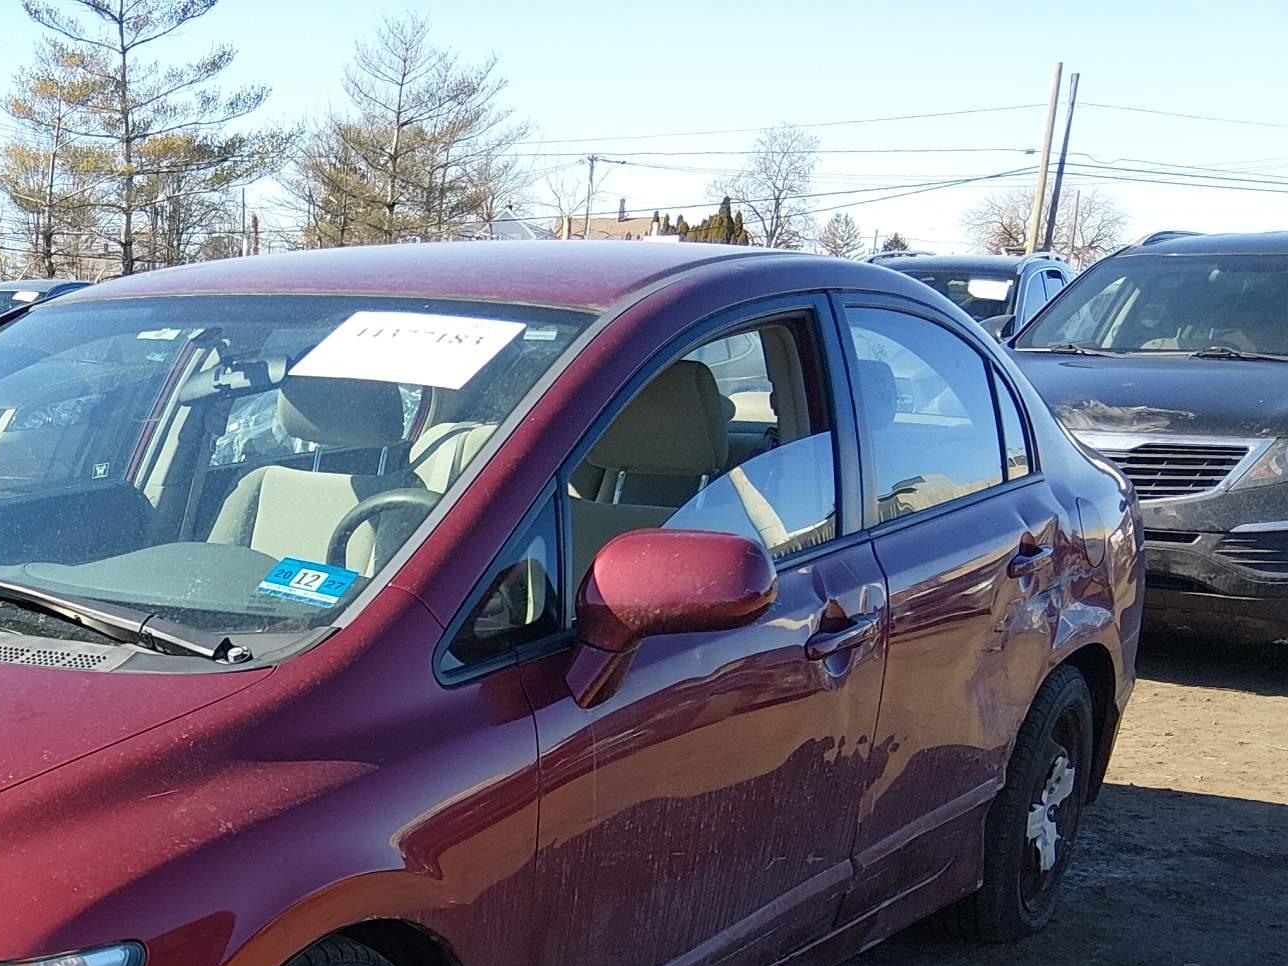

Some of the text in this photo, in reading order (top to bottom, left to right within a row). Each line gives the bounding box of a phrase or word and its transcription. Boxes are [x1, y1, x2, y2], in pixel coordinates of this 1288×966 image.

[274, 569, 345, 590] 20 12 27
